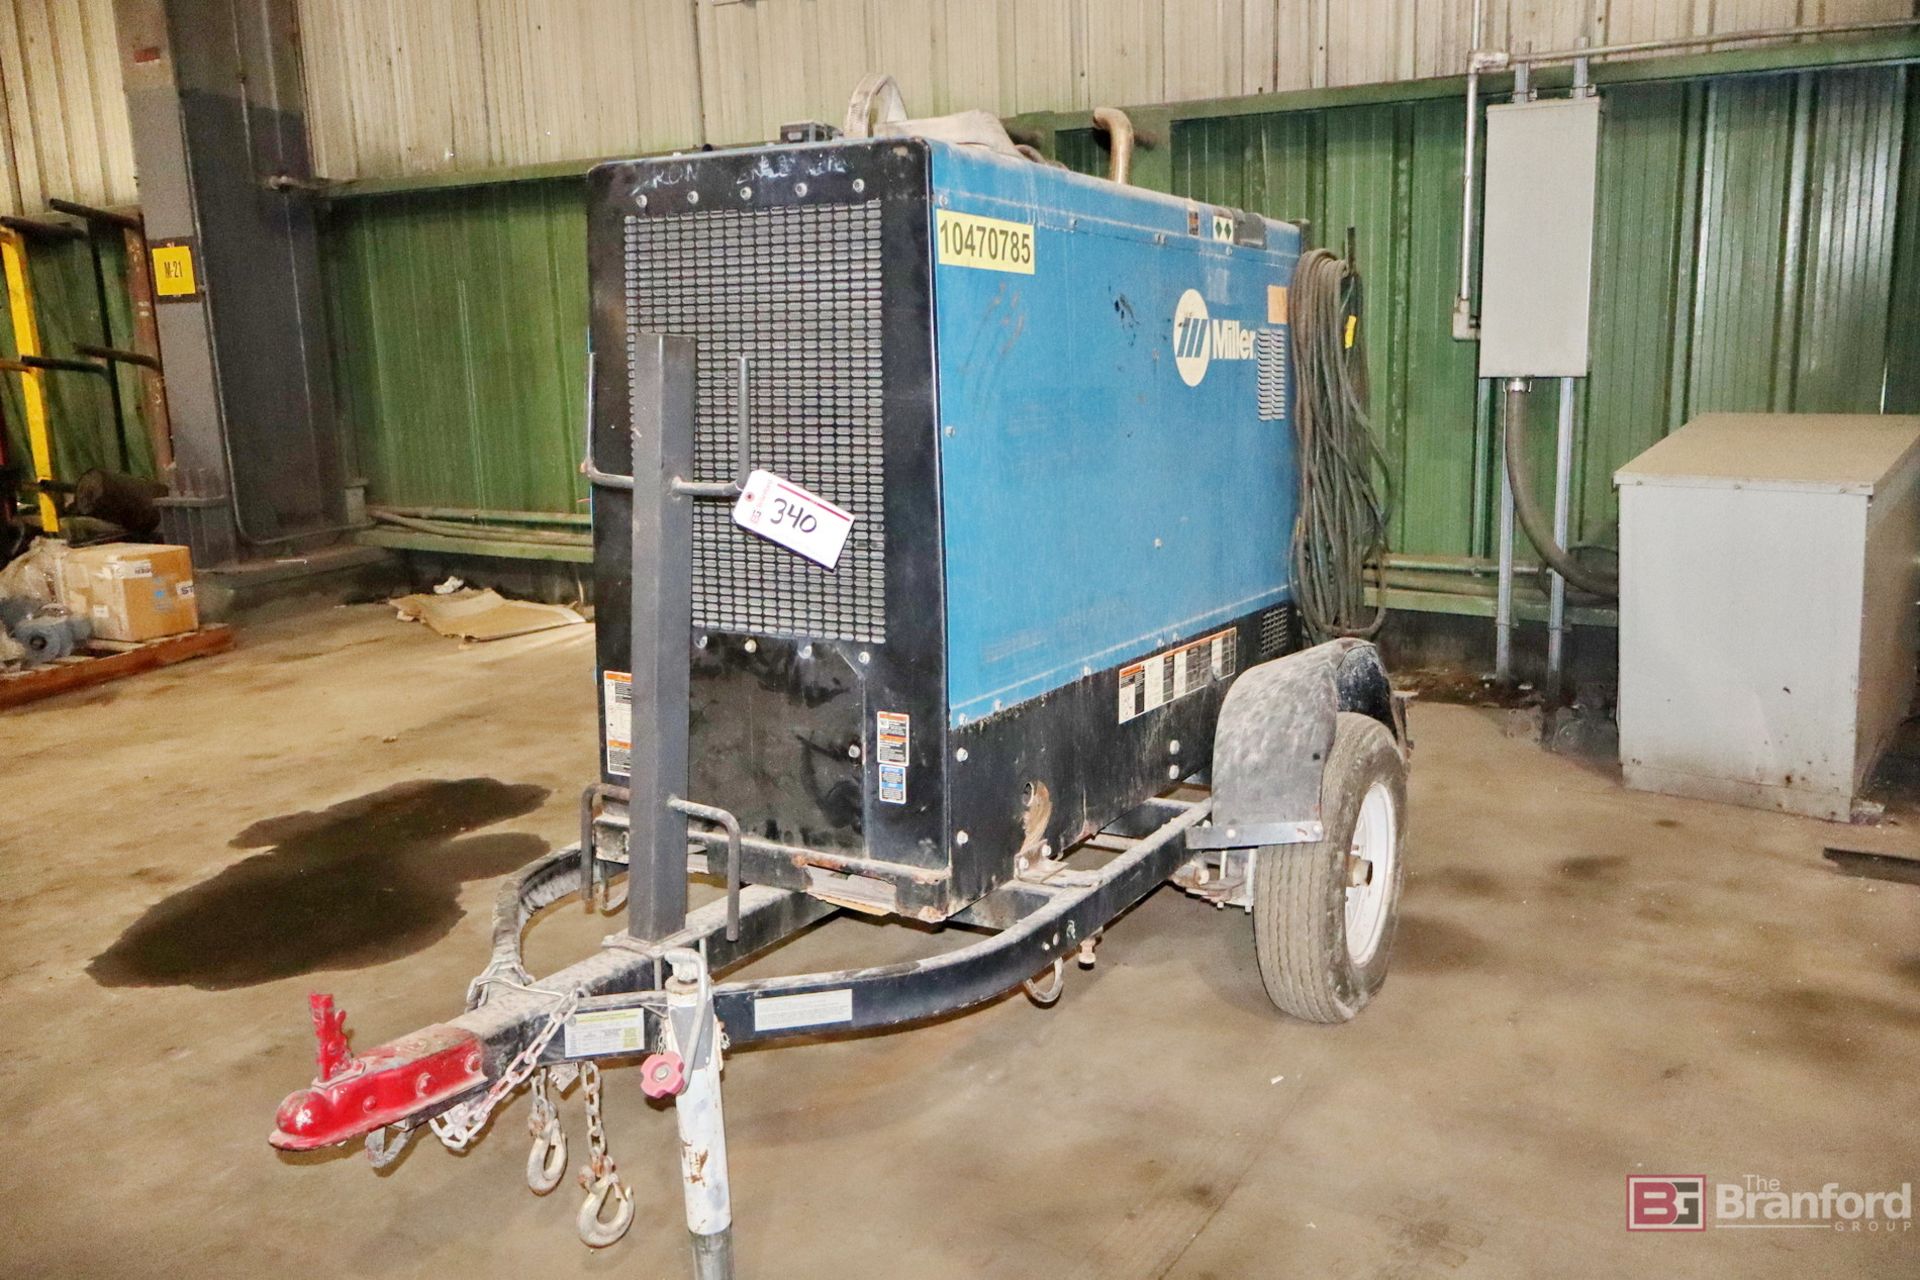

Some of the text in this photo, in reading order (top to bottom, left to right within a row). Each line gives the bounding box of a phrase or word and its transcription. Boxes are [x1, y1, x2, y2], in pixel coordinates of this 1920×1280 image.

[940, 219, 1031, 264] 10470785
[163, 260, 184, 279] M-21
[1212, 319, 1257, 360] Miller
[770, 497, 818, 533] 340
